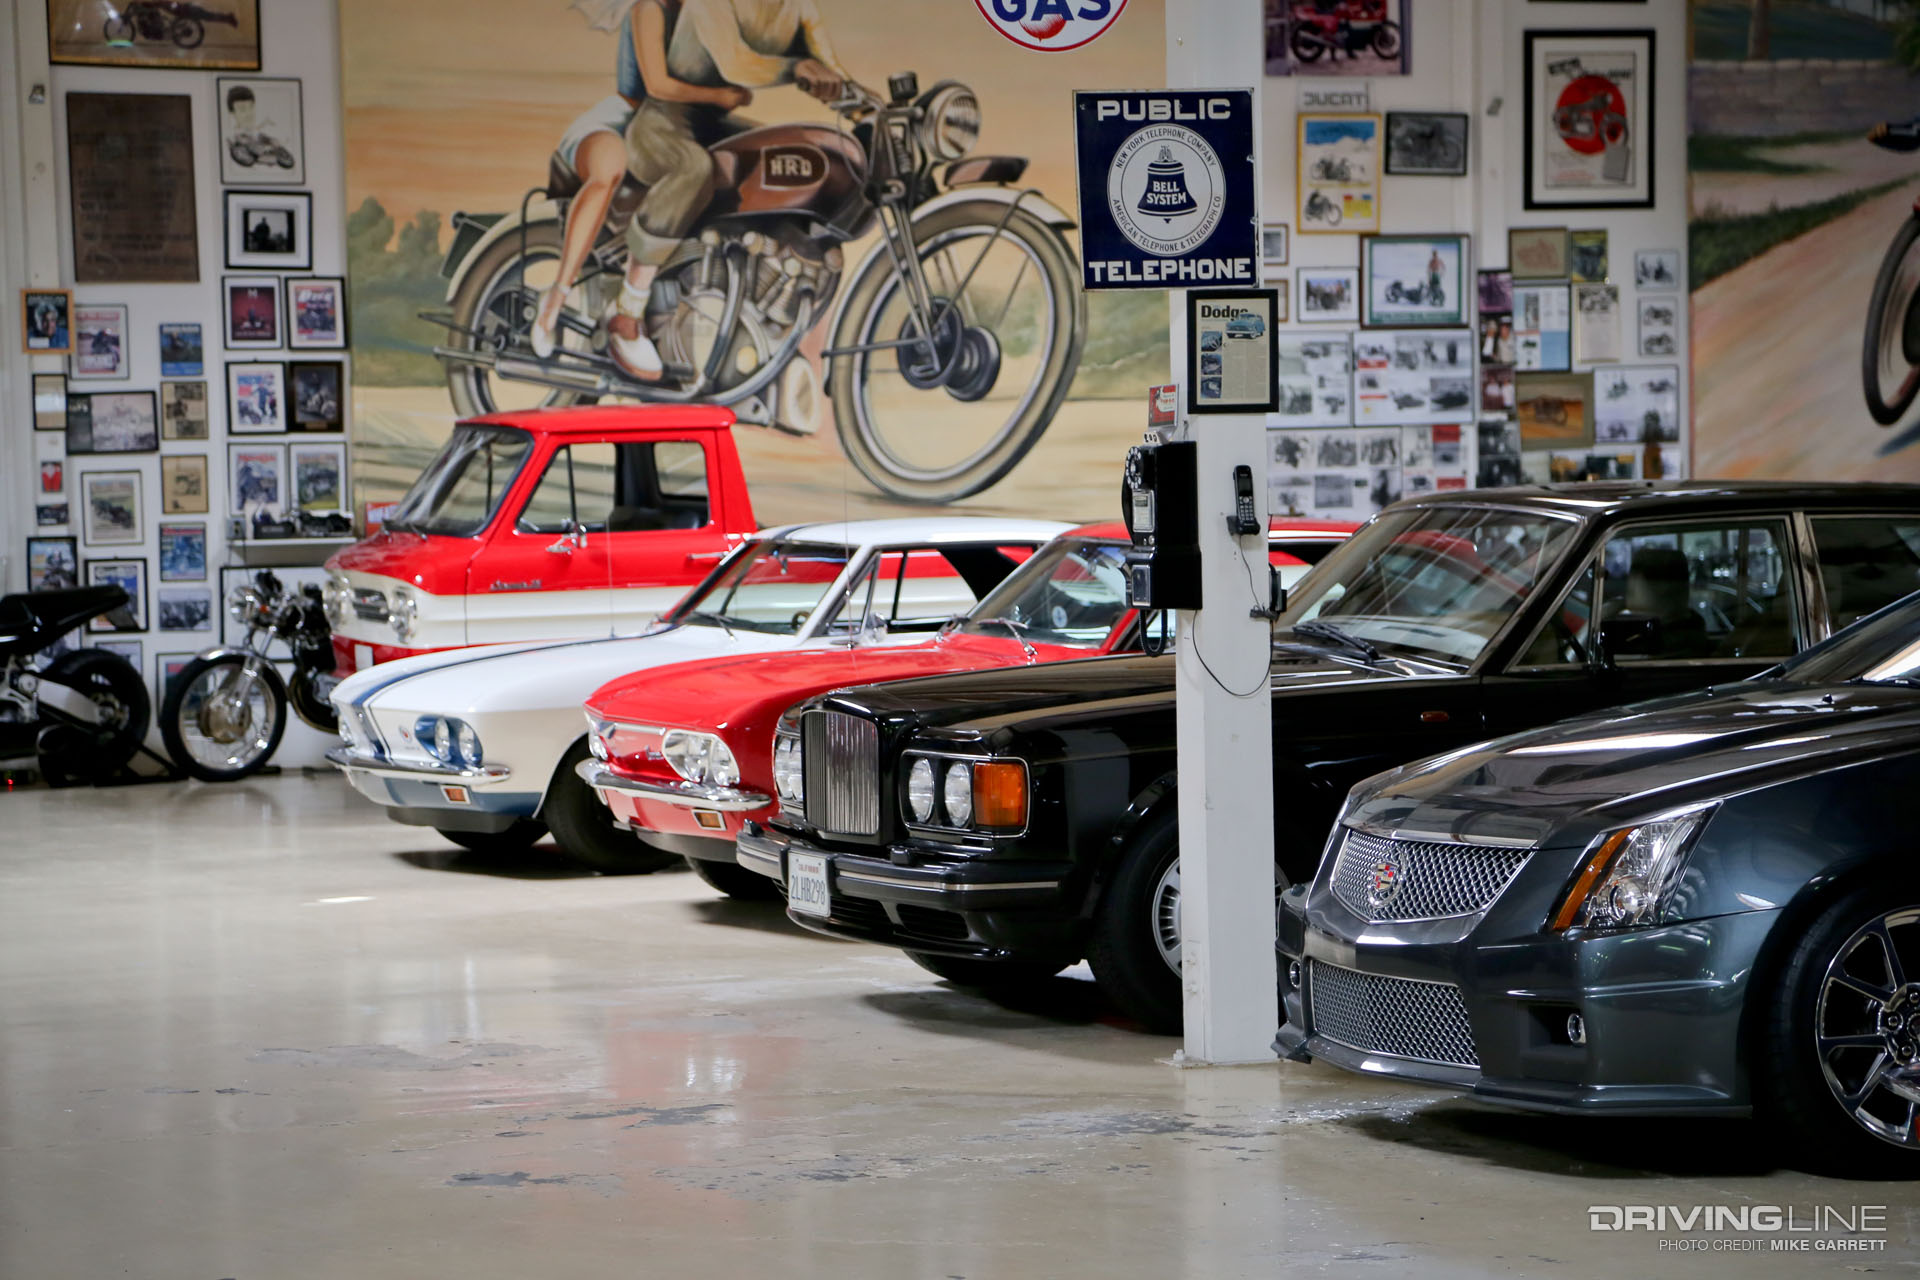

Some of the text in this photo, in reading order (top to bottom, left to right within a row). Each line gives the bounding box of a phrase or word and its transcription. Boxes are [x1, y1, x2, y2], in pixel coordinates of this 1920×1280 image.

[1097, 98, 1231, 121] PUBLIC
[1115, 128, 1217, 169] NEW YORK TELEPHONE COMPANY
[1146, 192, 1187, 205] SYSTEM
[1152, 181, 1180, 193] BELL
[1113, 199, 1140, 239] AMERICAN
[1139, 236, 1179, 252] TELEPHONE
[1180, 242, 1186, 250] &
[1186, 209, 1218, 247] TELEGRAPH
[1088, 257, 1251, 282] TELEPHONE
